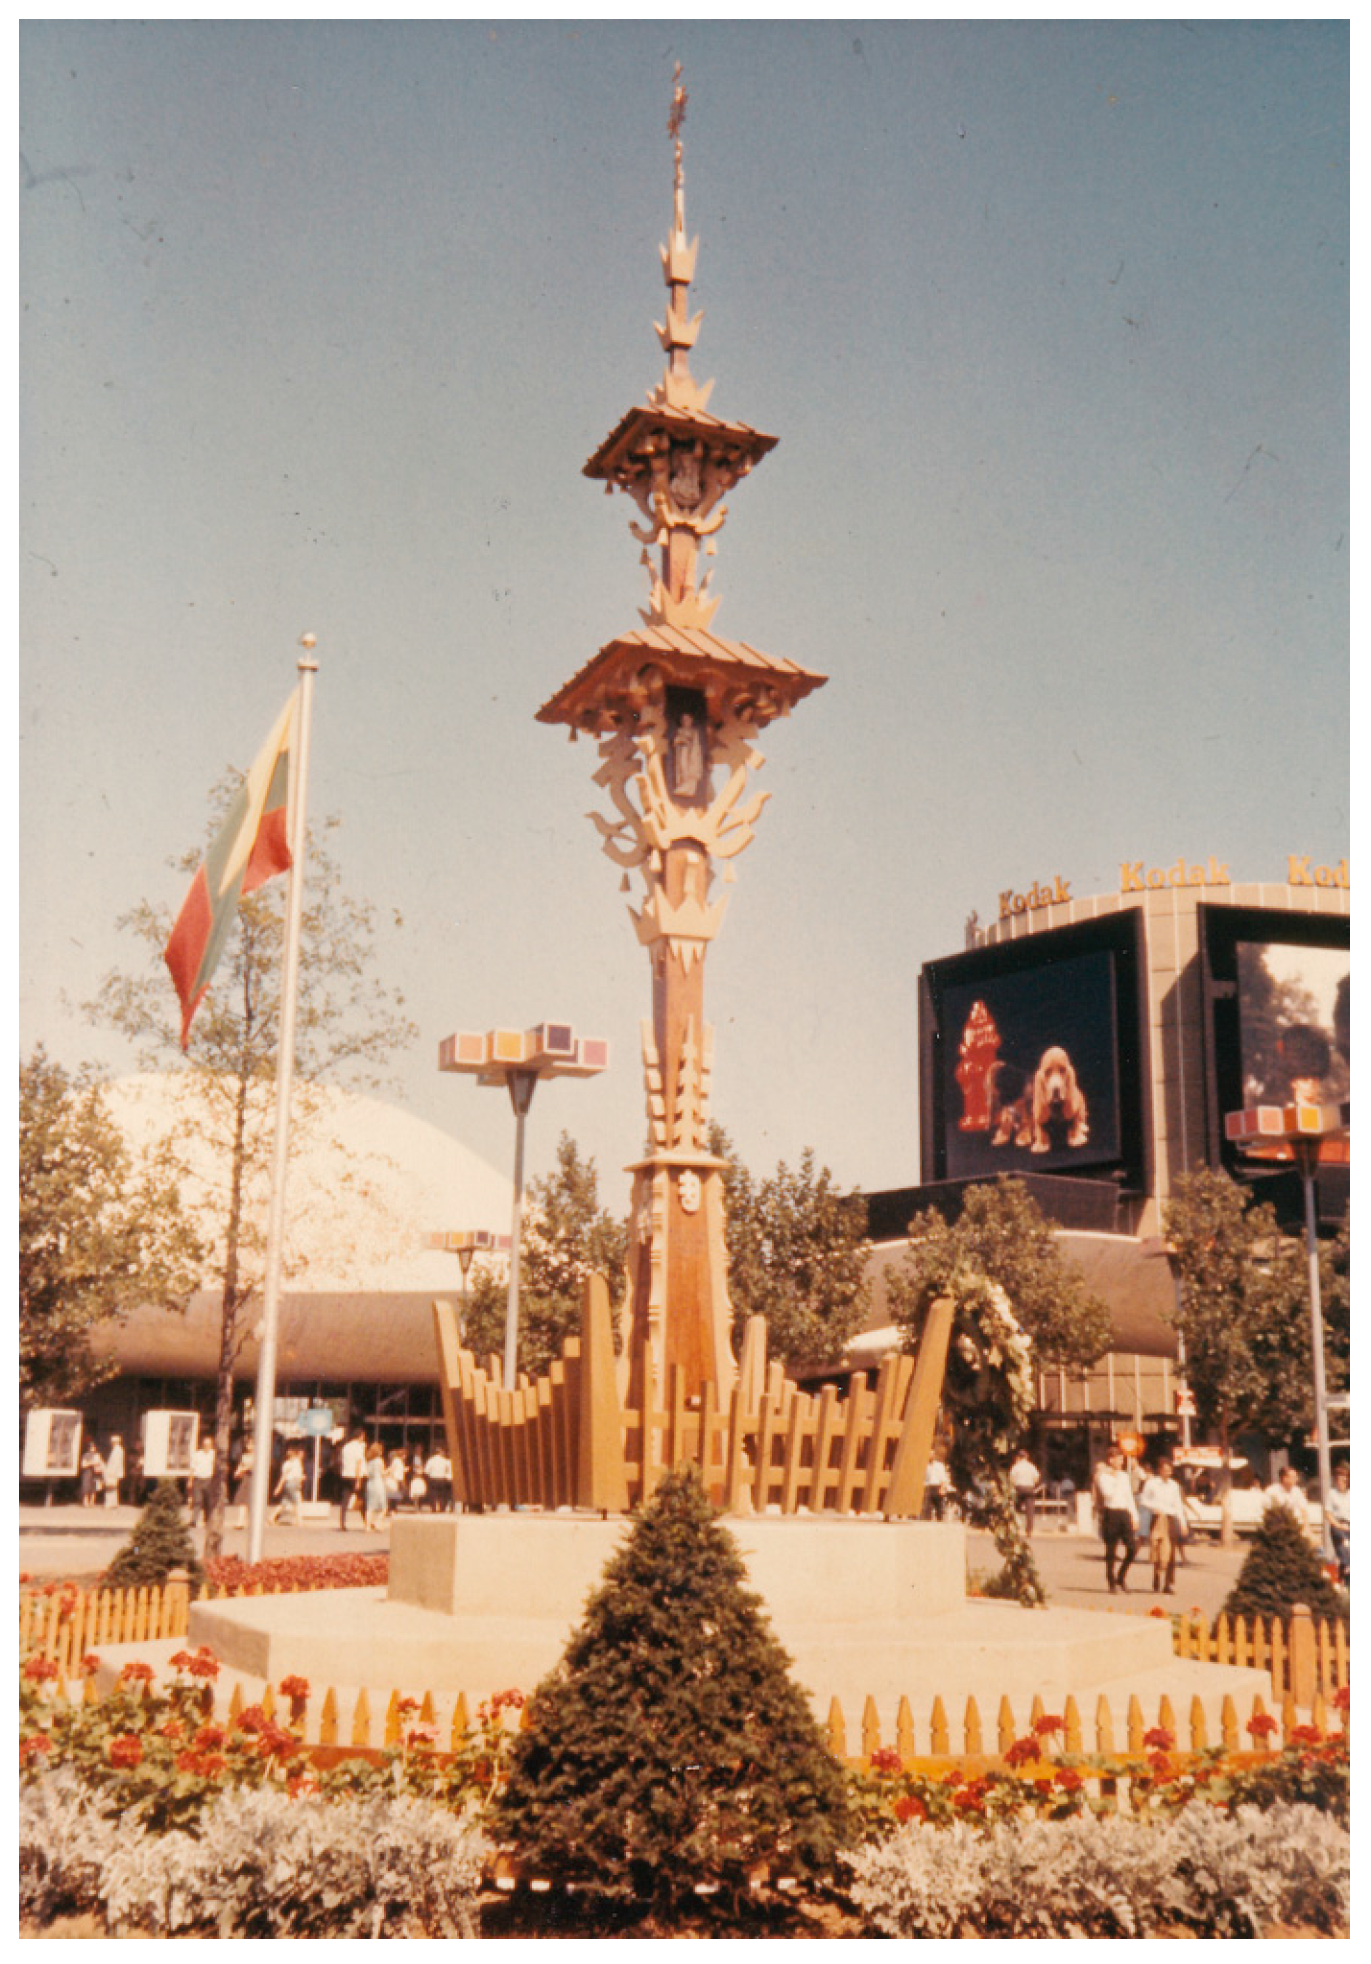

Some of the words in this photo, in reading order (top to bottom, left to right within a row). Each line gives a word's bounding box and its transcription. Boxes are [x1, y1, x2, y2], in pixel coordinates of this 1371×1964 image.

[1119, 856, 1230, 892] Kodak
[1287, 855, 1350, 889] Kod
[999, 874, 1072, 919] Kodak
